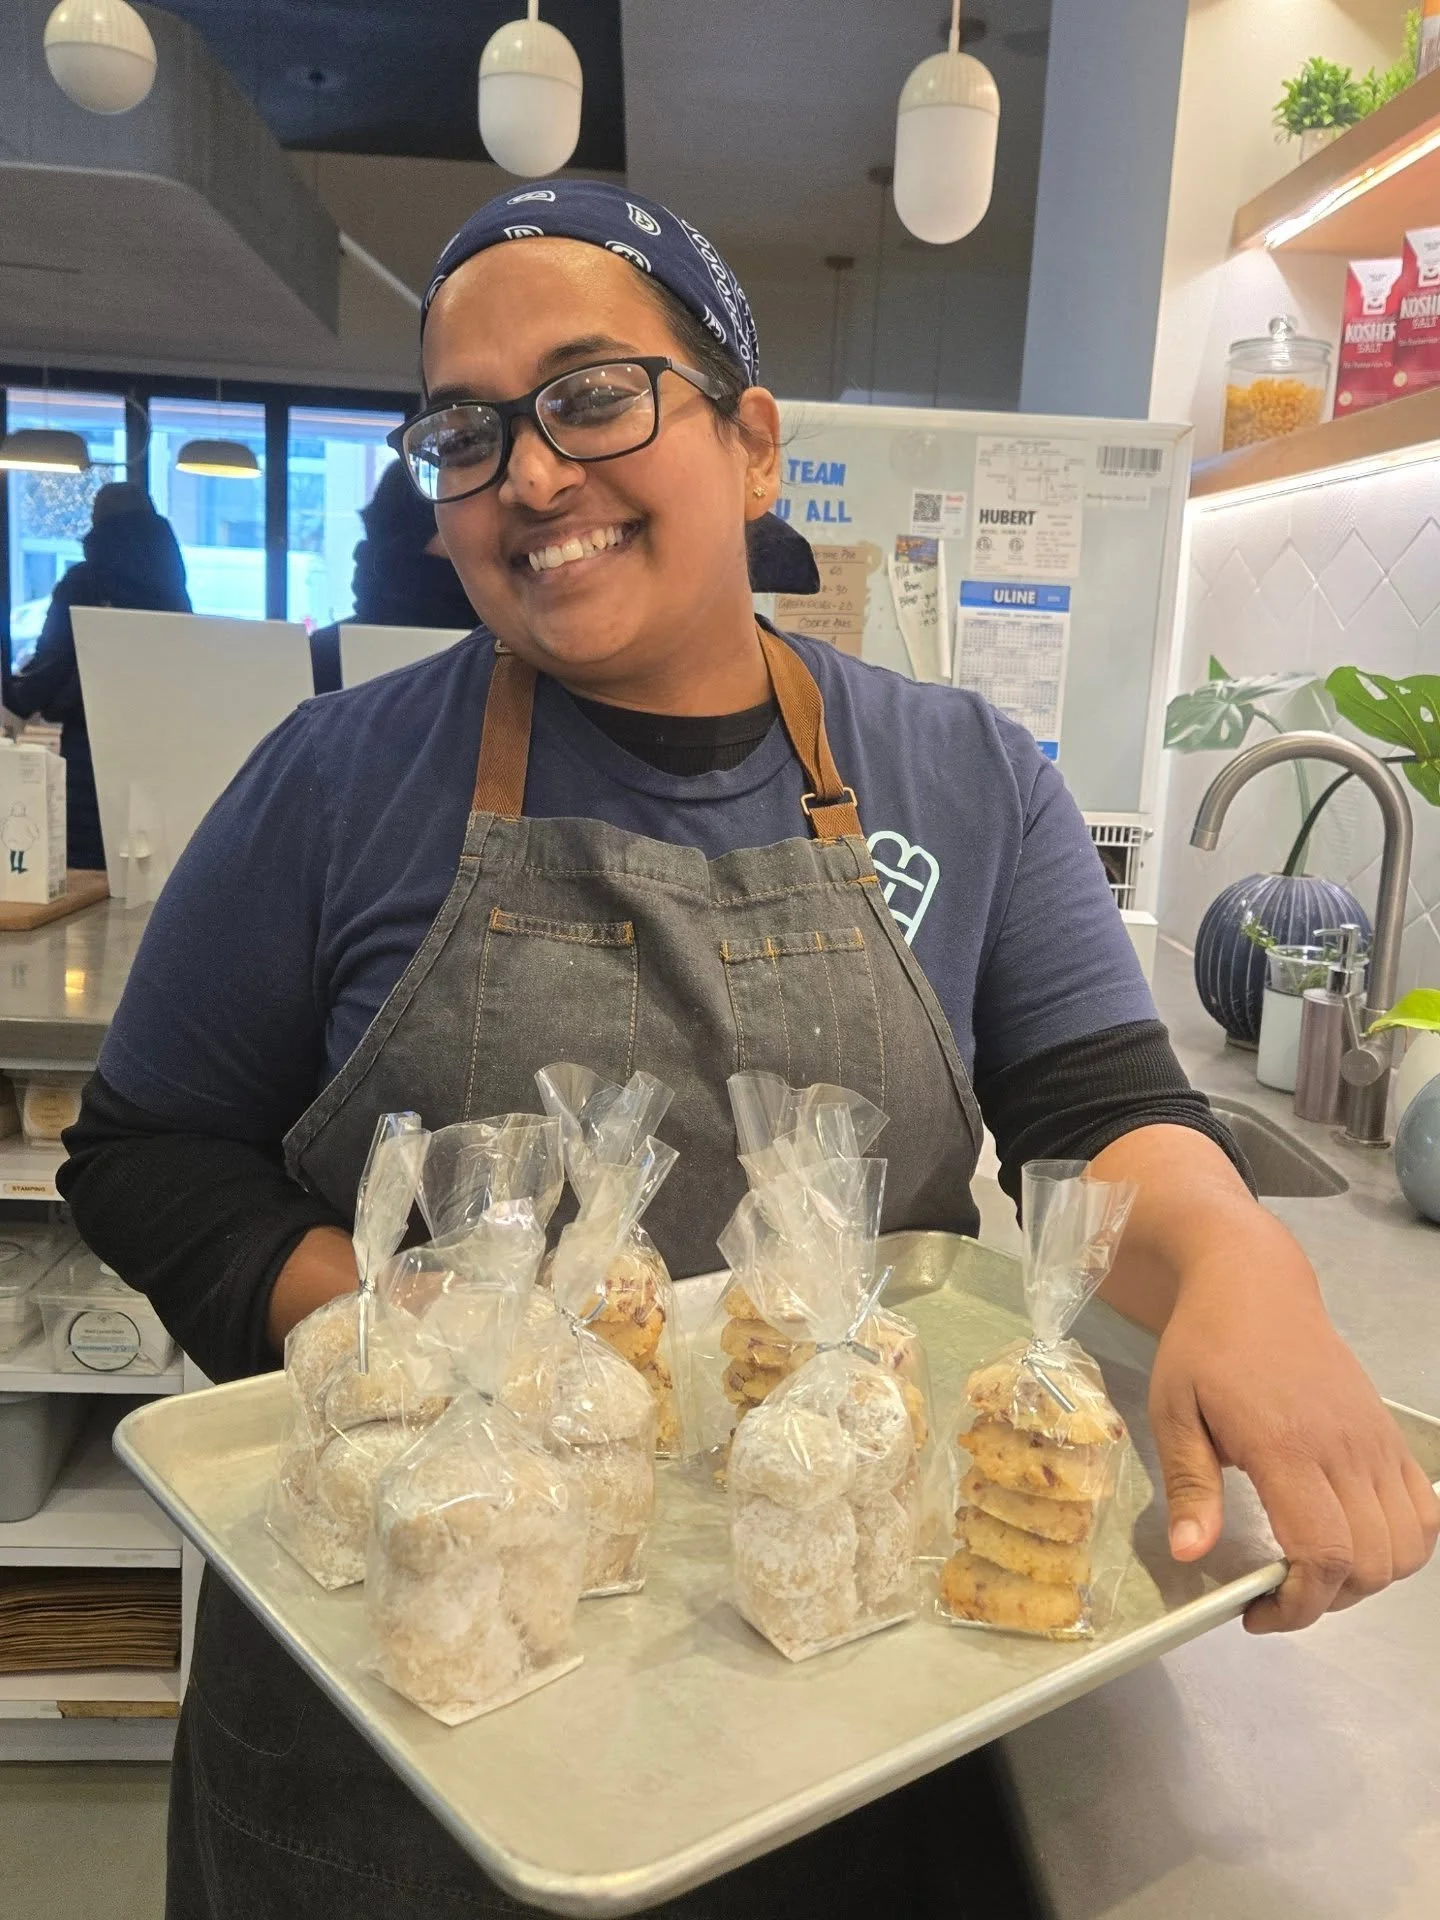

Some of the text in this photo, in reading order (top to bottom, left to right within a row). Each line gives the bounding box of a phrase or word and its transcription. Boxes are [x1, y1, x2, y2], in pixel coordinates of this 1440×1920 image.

[1400, 293, 1440, 320] KOSH
[1411, 317, 1439, 330] SALT
[1357, 343, 1382, 354] SALT
[787, 458, 847, 487] TEAM
[806, 499, 852, 523] ALL
[978, 508, 1038, 526] HUBERT
[993, 589, 1037, 605] ULINE
[11, 1182, 46, 1193] STAMPING
